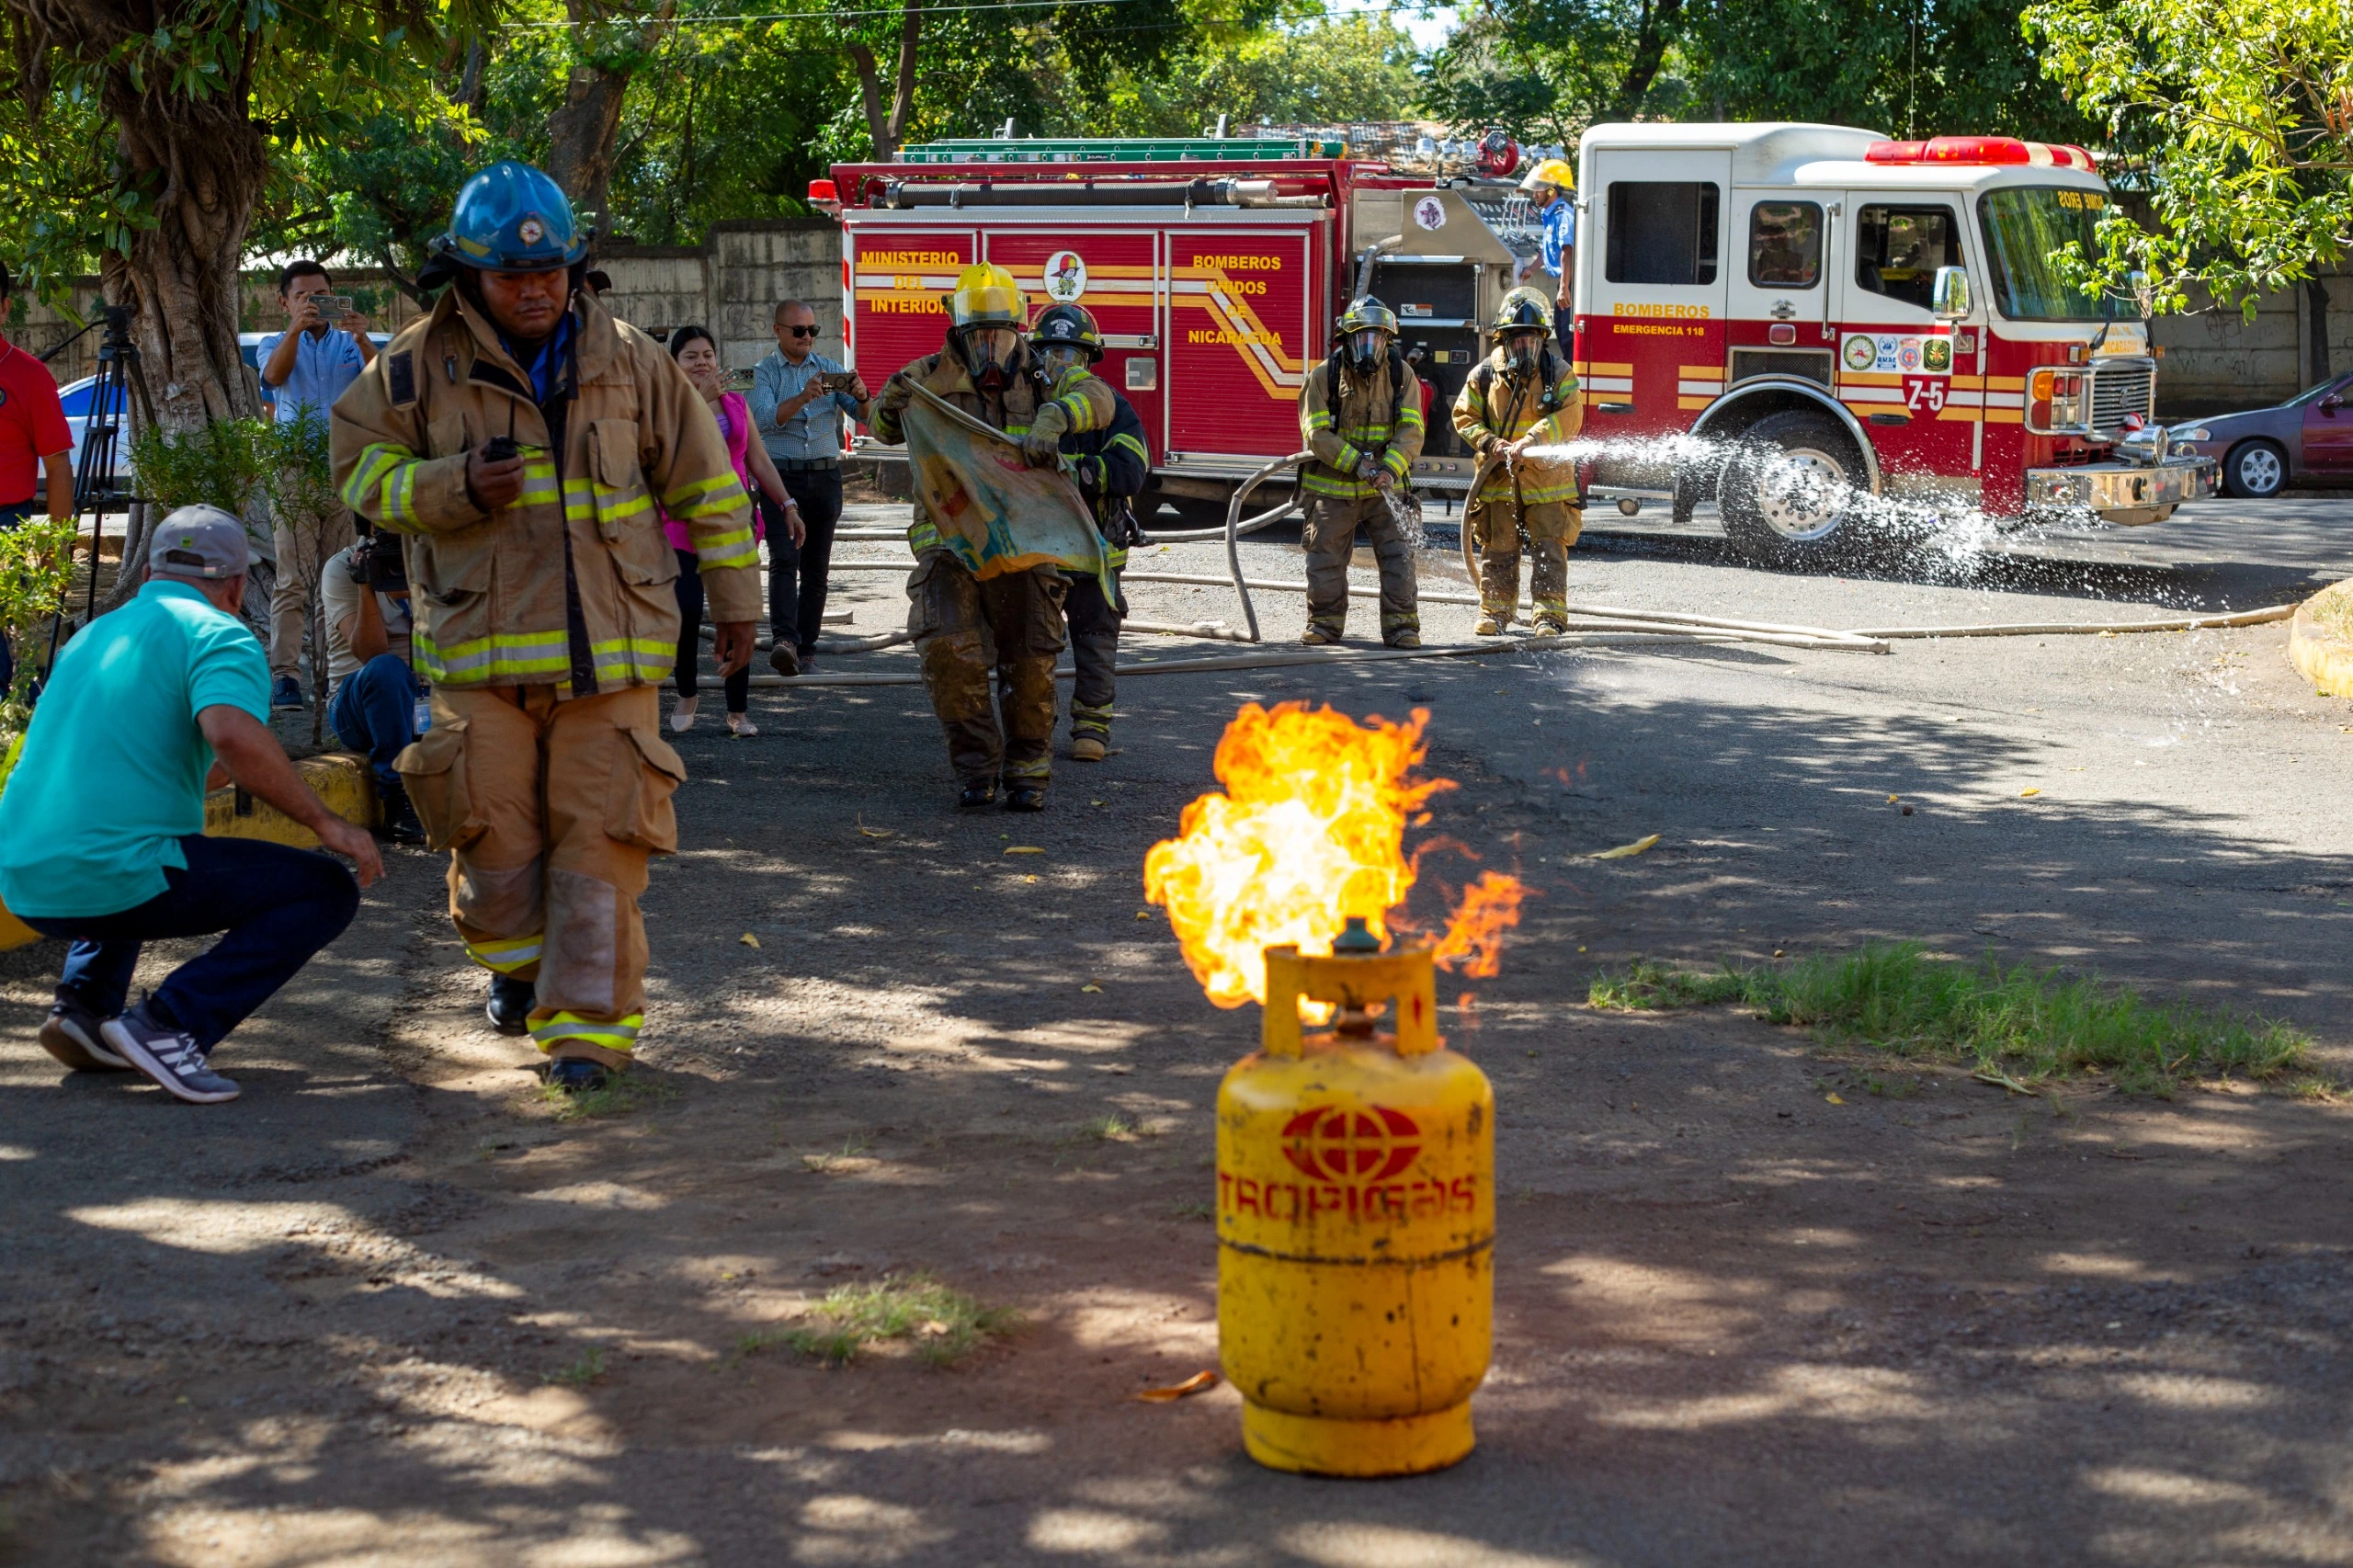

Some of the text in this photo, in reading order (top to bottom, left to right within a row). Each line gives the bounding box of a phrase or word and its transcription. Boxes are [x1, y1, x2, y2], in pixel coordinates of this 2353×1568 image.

[861, 251, 960, 267] MINISTERIO
[1193, 255, 1281, 270] BOMBEROS
[893, 275, 926, 290] DEL
[1206, 280, 1267, 295] UNIDOS
[1227, 304, 1247, 319] DE
[1613, 302, 1710, 319] BOMBEROS
[1613, 324, 1704, 336] EMERGENCIA 118
[1188, 330, 1283, 346] NICARAGUA
[1908, 380, 1944, 411] Z-5
